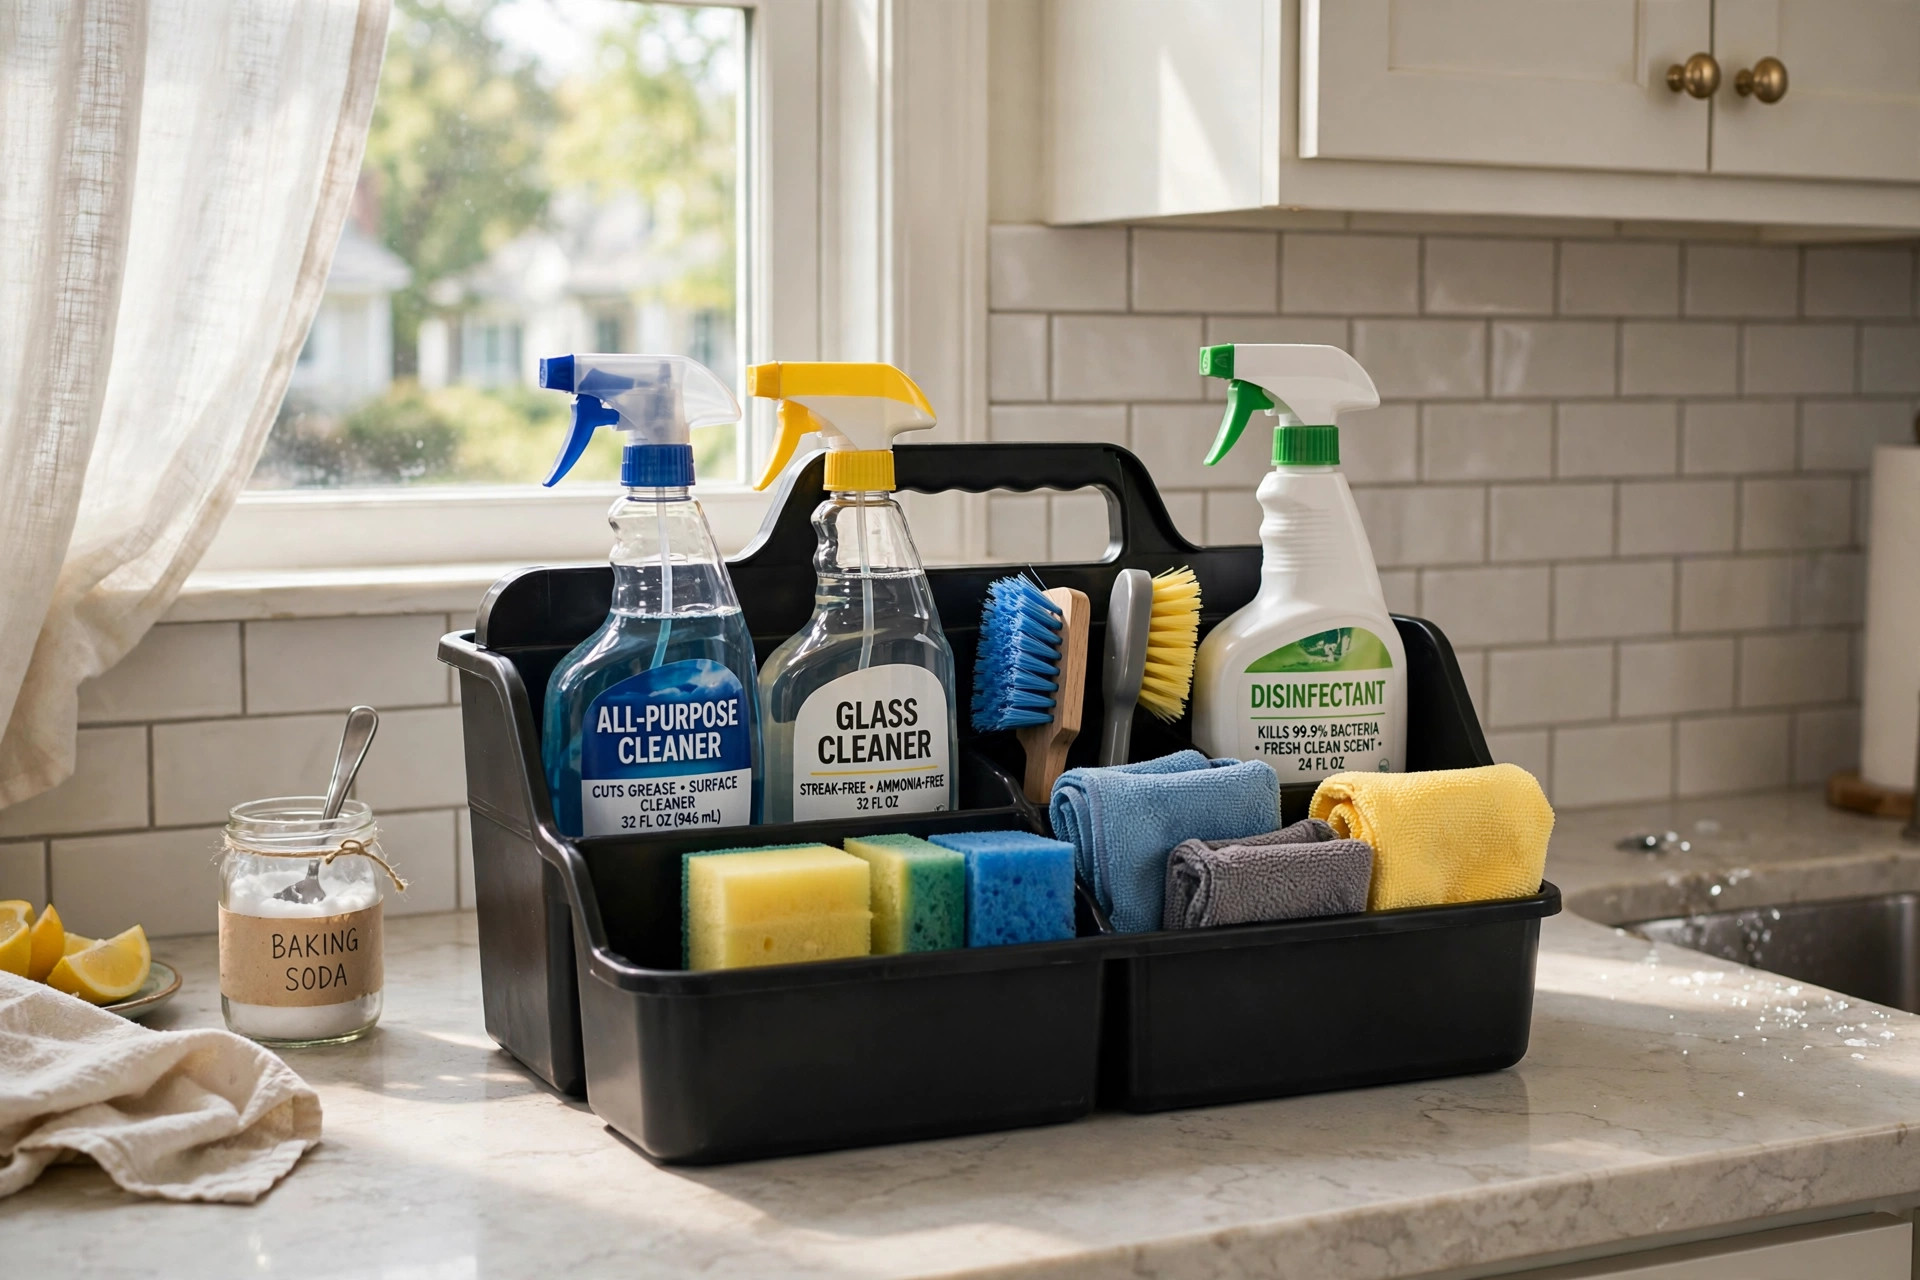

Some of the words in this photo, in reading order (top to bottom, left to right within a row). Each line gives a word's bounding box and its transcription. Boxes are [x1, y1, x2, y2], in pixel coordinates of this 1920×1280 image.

[1251, 680, 1386, 708] DISINFECTANT
[597, 699, 738, 733] ALL-PURPOSE
[836, 698, 918, 730] GLASS
[1258, 725, 1289, 739] KILLS
[1292, 724, 1328, 738] 99.9%
[1330, 722, 1380, 737] BACTERIA
[618, 732, 722, 764] CLEANER
[818, 730, 931, 764] CLEANER
[1264, 741, 1300, 755] FRESH
[1304, 740, 1341, 754] CLEAN
[1343, 738, 1376, 752] SCENT
[1298, 757, 1312, 771] 24
[1316, 757, 1328, 770] FL
[1330, 756, 1345, 770] OZ
[592, 784, 624, 798] CUTS
[628, 782, 676, 796] GREASE
[689, 776, 738, 793] SURFACE
[800, 781, 866, 796] STREAK-FREE
[640, 796, 696, 812] CLEANER
[856, 797, 869, 810] 32
[872, 797, 883, 809] FL
[885, 795, 899, 808] OZ
[621, 815, 636, 829] 32
[639, 814, 653, 828] FL
[656, 813, 672, 827] OZ
[674, 811, 699, 828] (946
[701, 809, 721, 824] mL)
[271, 927, 359, 959] BAKING
[285, 963, 348, 991] SODA
